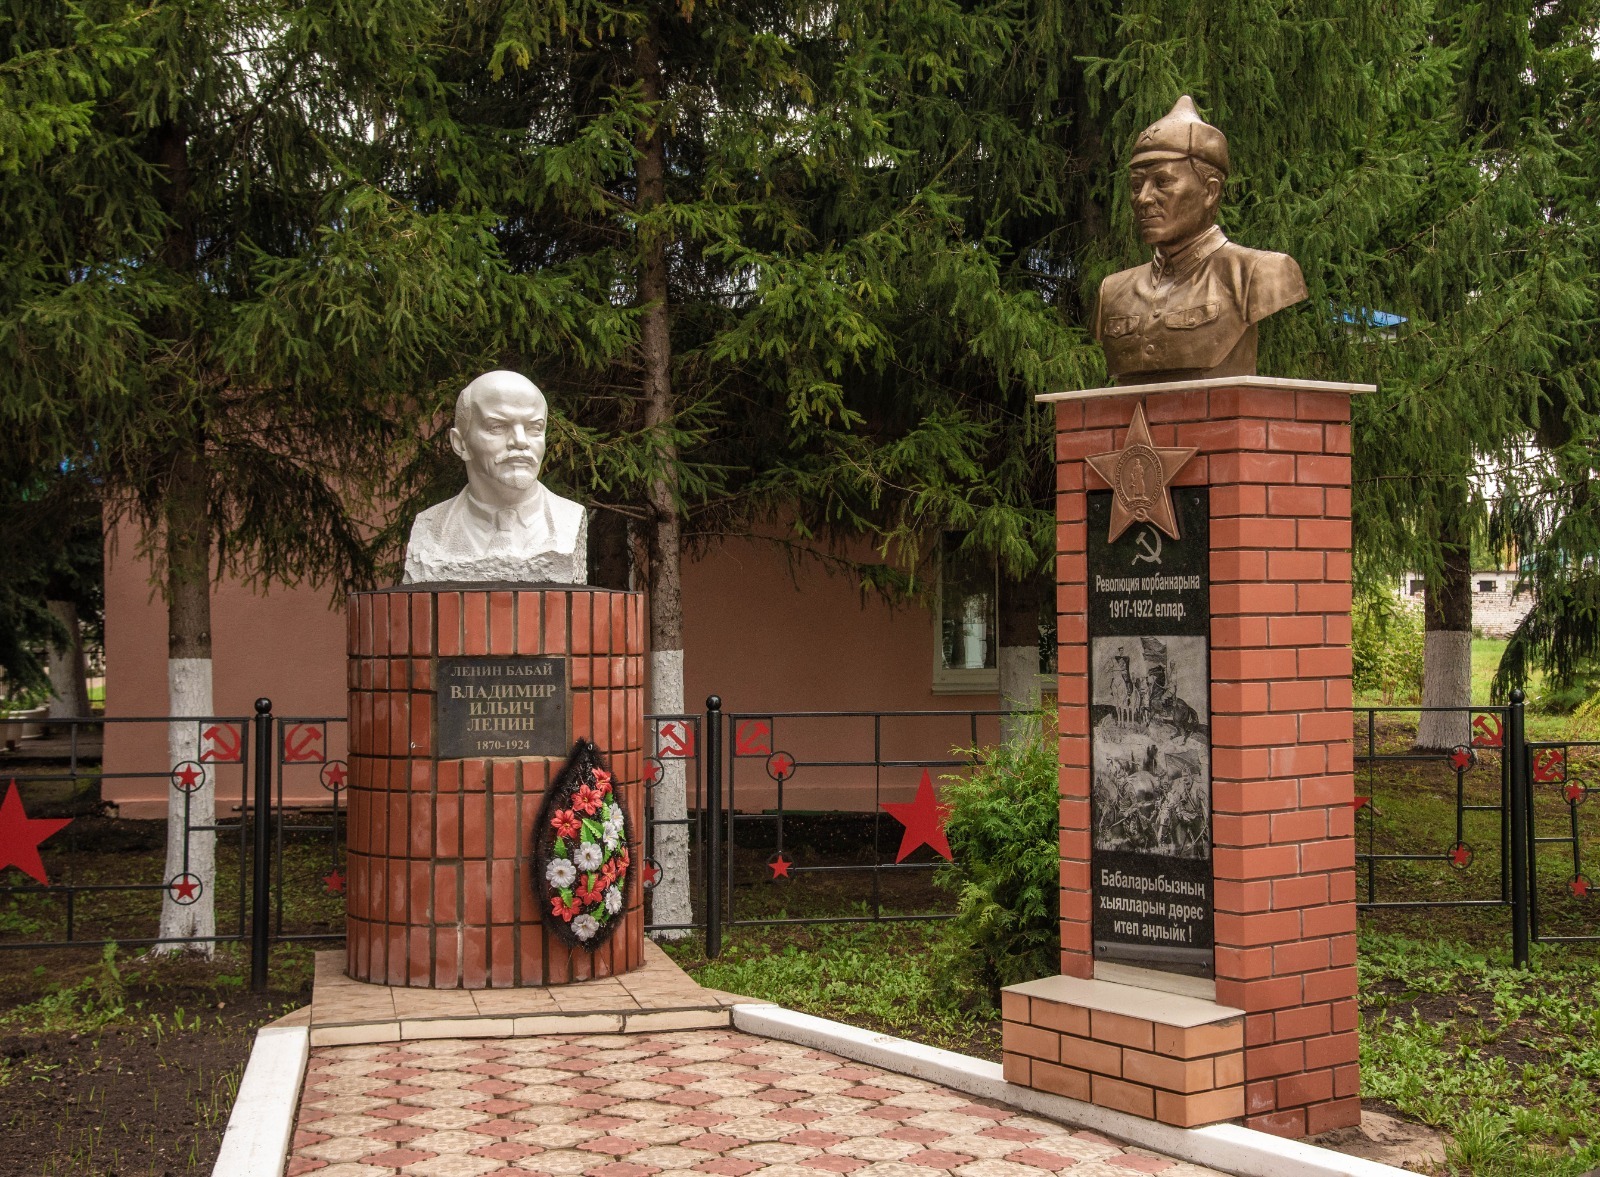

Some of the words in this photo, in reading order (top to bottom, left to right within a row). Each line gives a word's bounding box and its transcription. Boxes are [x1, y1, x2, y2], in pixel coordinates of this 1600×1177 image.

[1095, 574, 1140, 594] Революция
[1141, 572, 1200, 595] корбаннарына
[1109, 599, 1153, 618] 1917-1922
[1155, 602, 1187, 621] еллар.
[451, 665, 502, 677] ЛЕНИН
[506, 662, 553, 676] БАБАЙ
[450, 684, 556, 701] ВЛАДИМИР
[468, 701, 536, 715] ИЛЬИЧ
[467, 717, 535, 731] ЛЕНИН
[476, 740, 530, 750] 1870-1924
[1101, 869, 1206, 900] Бабаларыбызның
[1099, 895, 1166, 918] хыялларын
[1168, 903, 1204, 923] дөрес
[1114, 920, 1139, 936] итеп
[1142, 922, 1186, 942] аңлыйк
